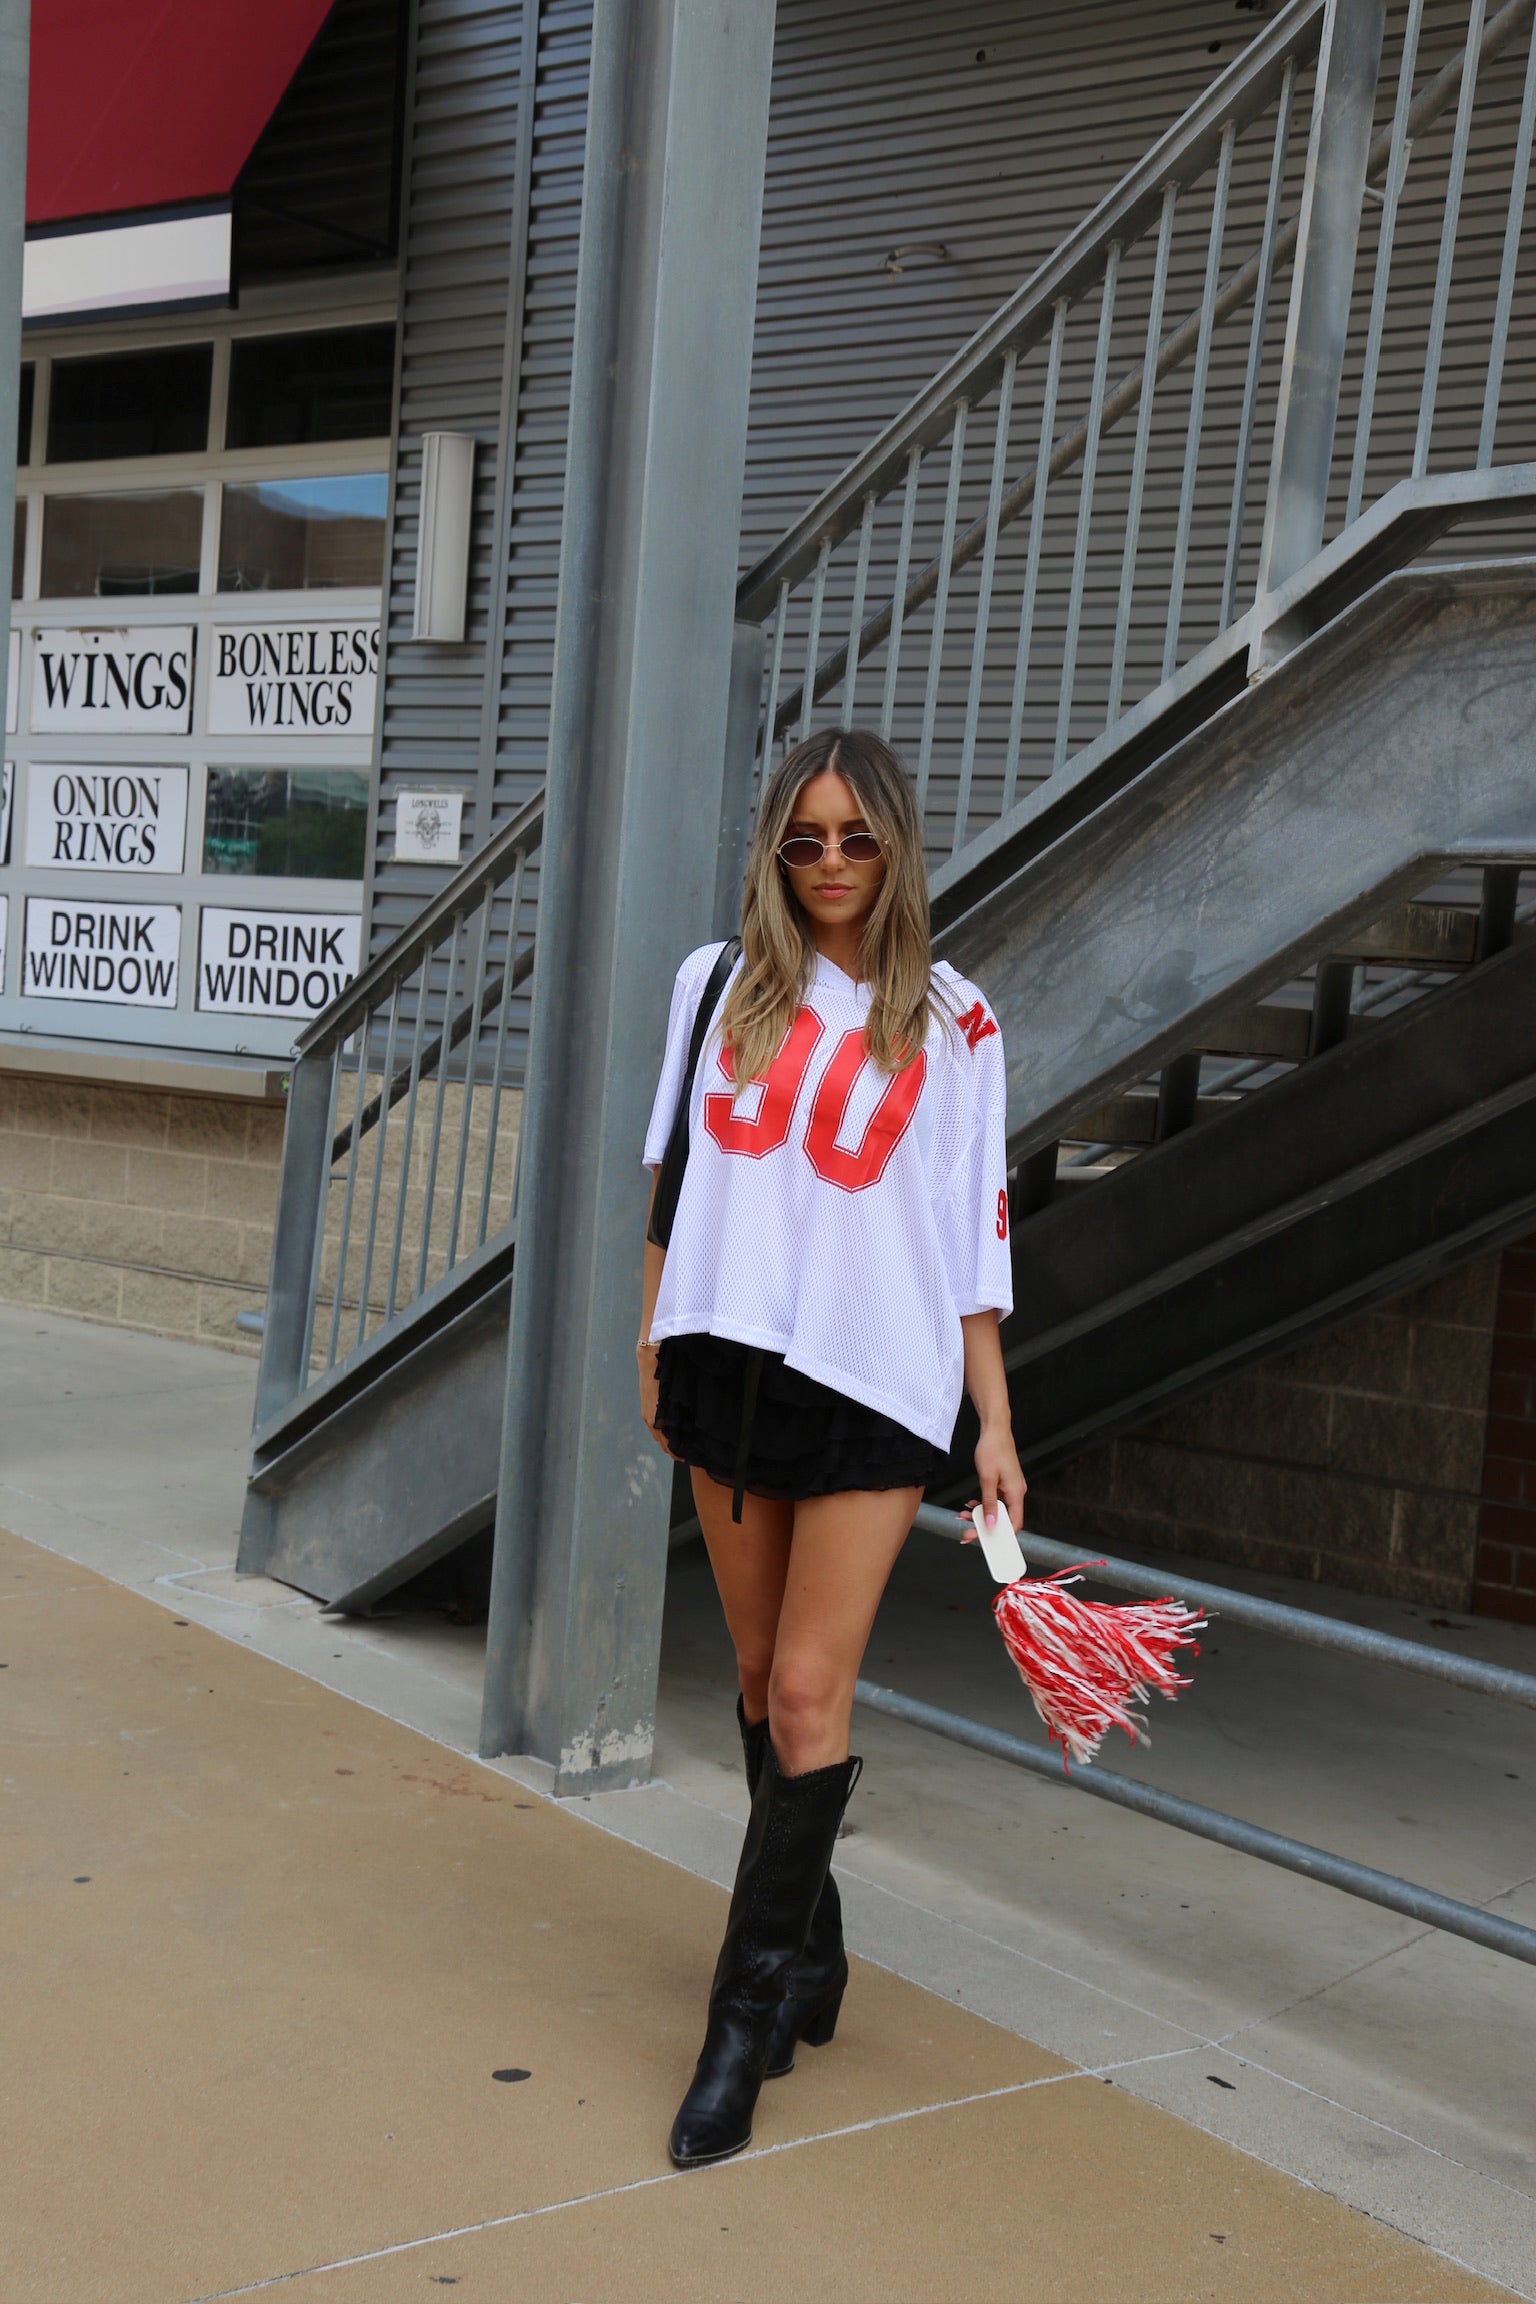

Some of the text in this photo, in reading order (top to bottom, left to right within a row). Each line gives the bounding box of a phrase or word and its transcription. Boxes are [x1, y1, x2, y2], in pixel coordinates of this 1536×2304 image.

[40, 651, 188, 711] WINGS
[246, 680, 353, 727] WINGS
[53, 774, 162, 819] ONION
[52, 821, 156, 865] RINGS
[51, 911, 155, 953] DRINK
[228, 922, 345, 966] DRINK
[30, 951, 175, 997] WINDOW
[955, 1000, 999, 1055] N
[704, 1003, 928, 1193] 90
